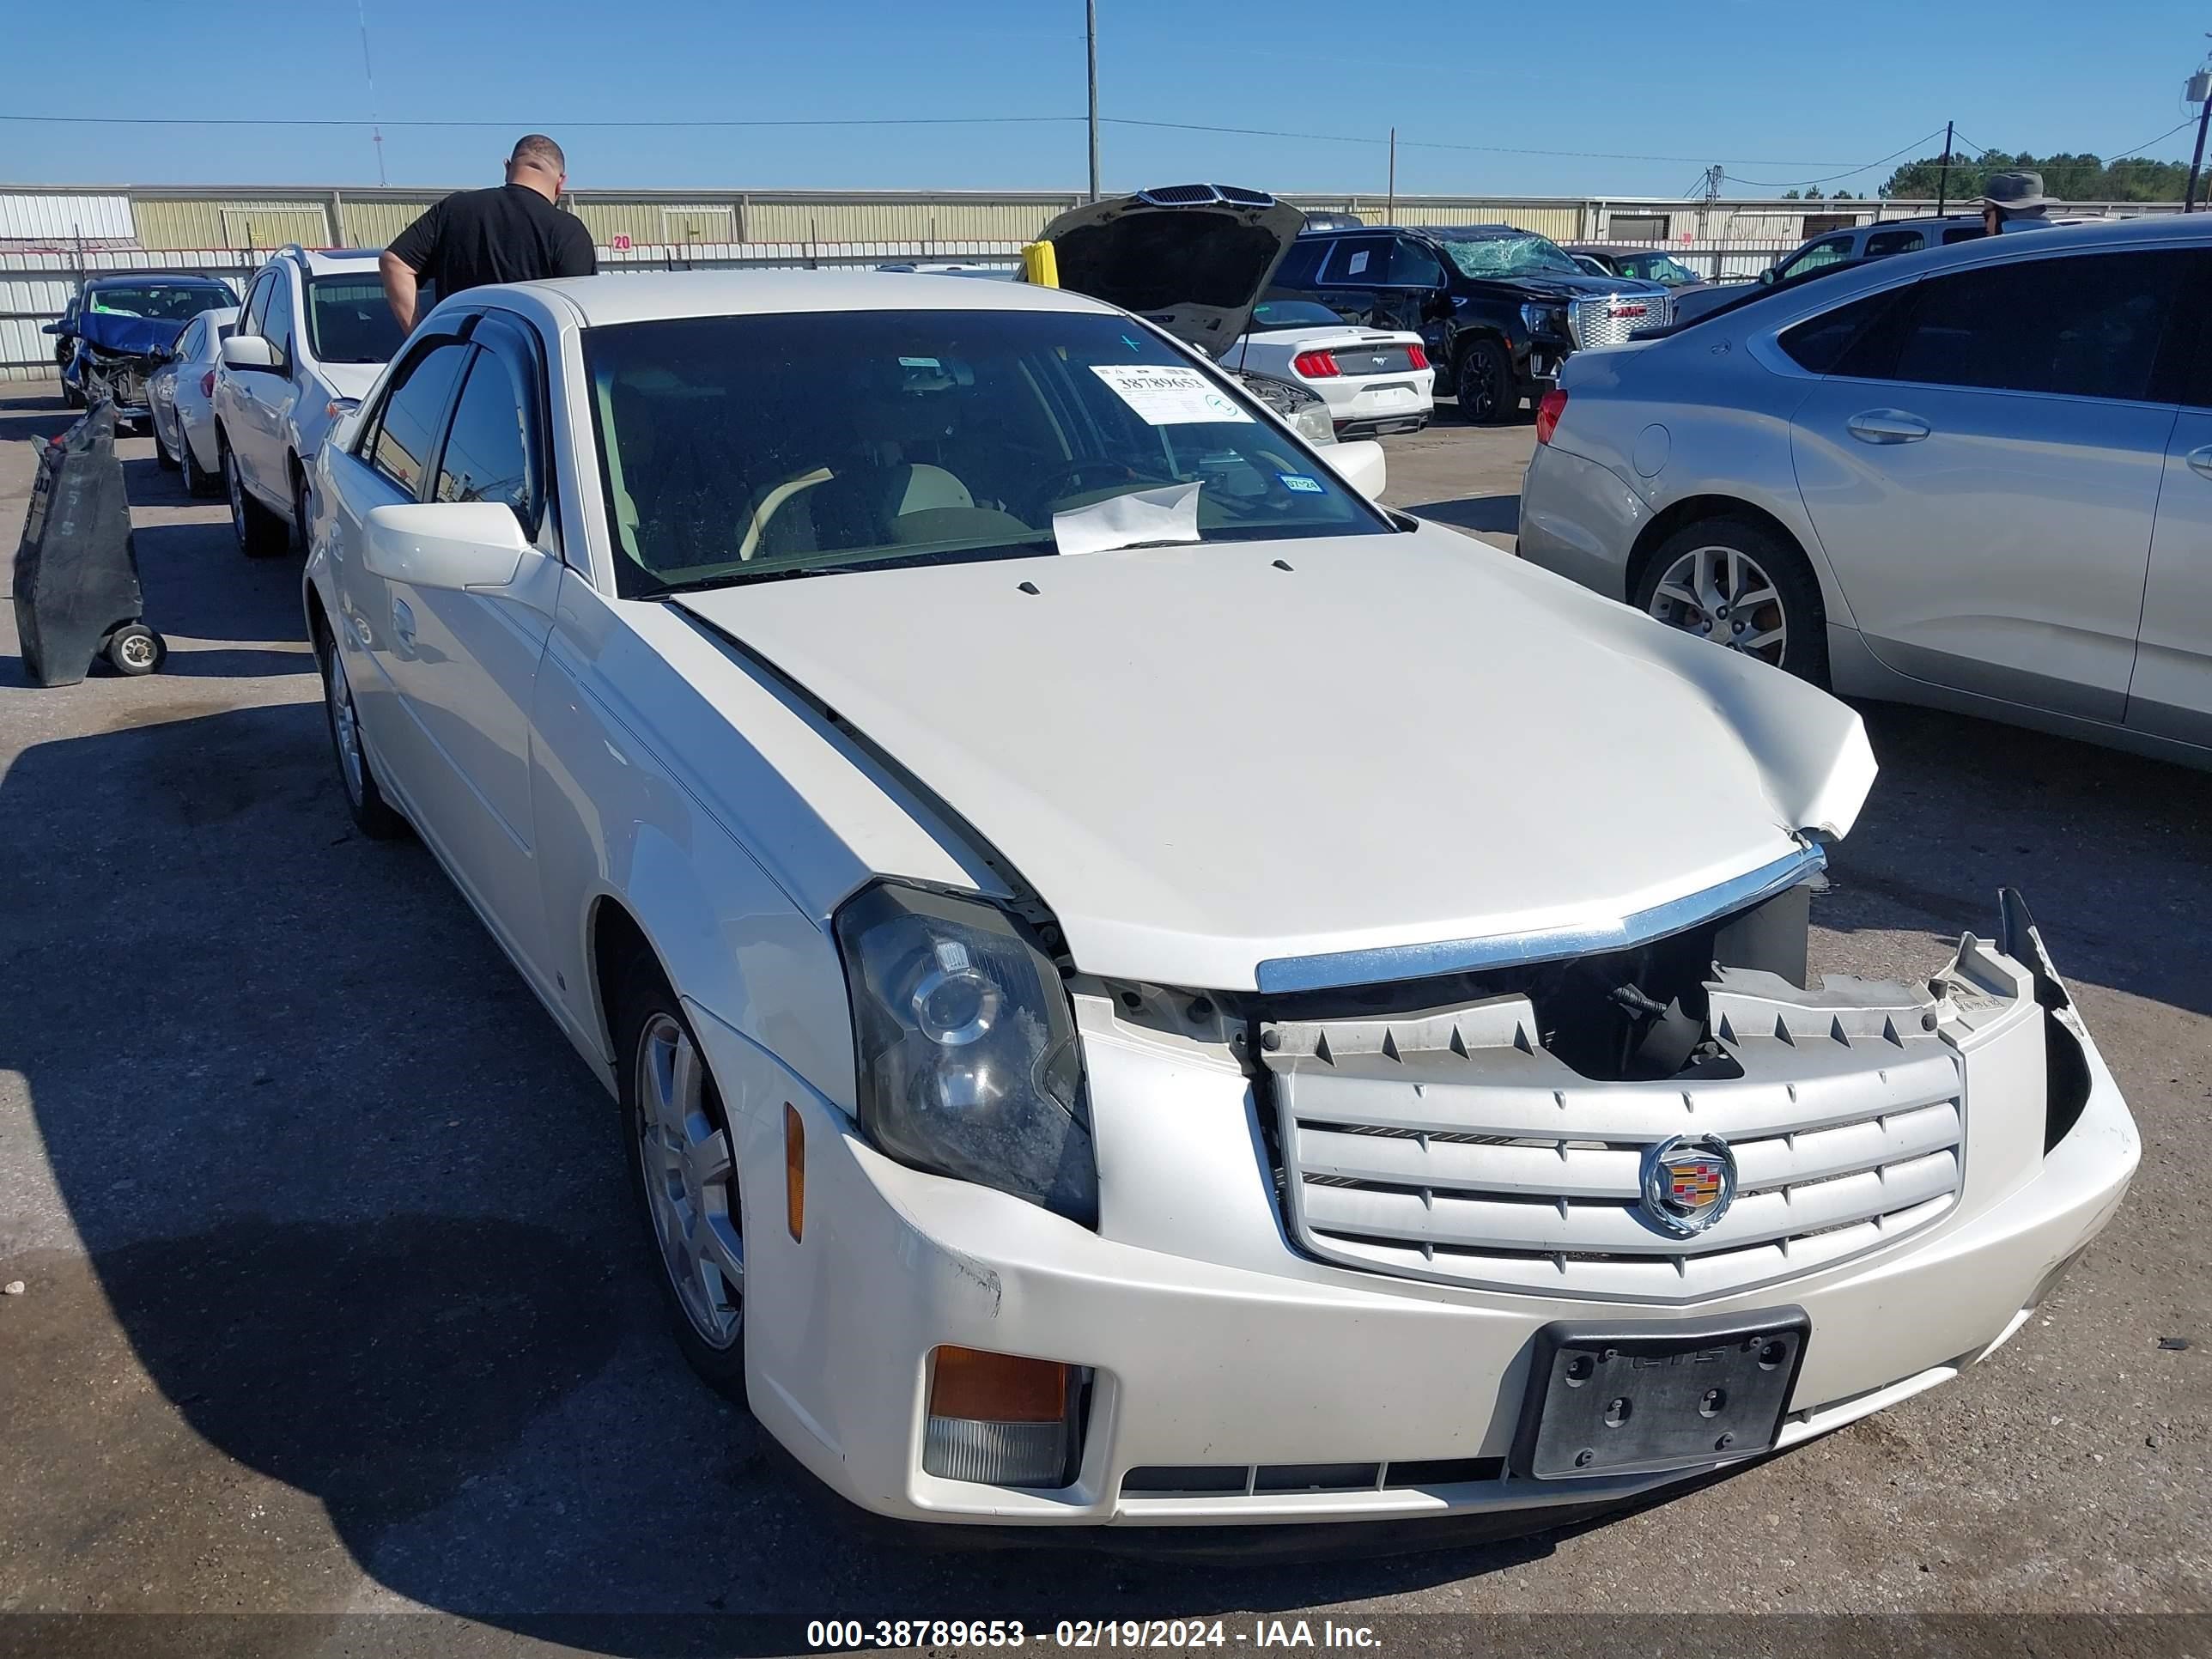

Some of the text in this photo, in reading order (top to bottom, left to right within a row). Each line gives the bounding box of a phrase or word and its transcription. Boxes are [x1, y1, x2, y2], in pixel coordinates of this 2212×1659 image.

[613, 235, 630, 249] 20
[1611, 305, 1647, 318] GMC
[1115, 377, 1205, 390] 38789653
[1304, 480, 1318, 489] 24
